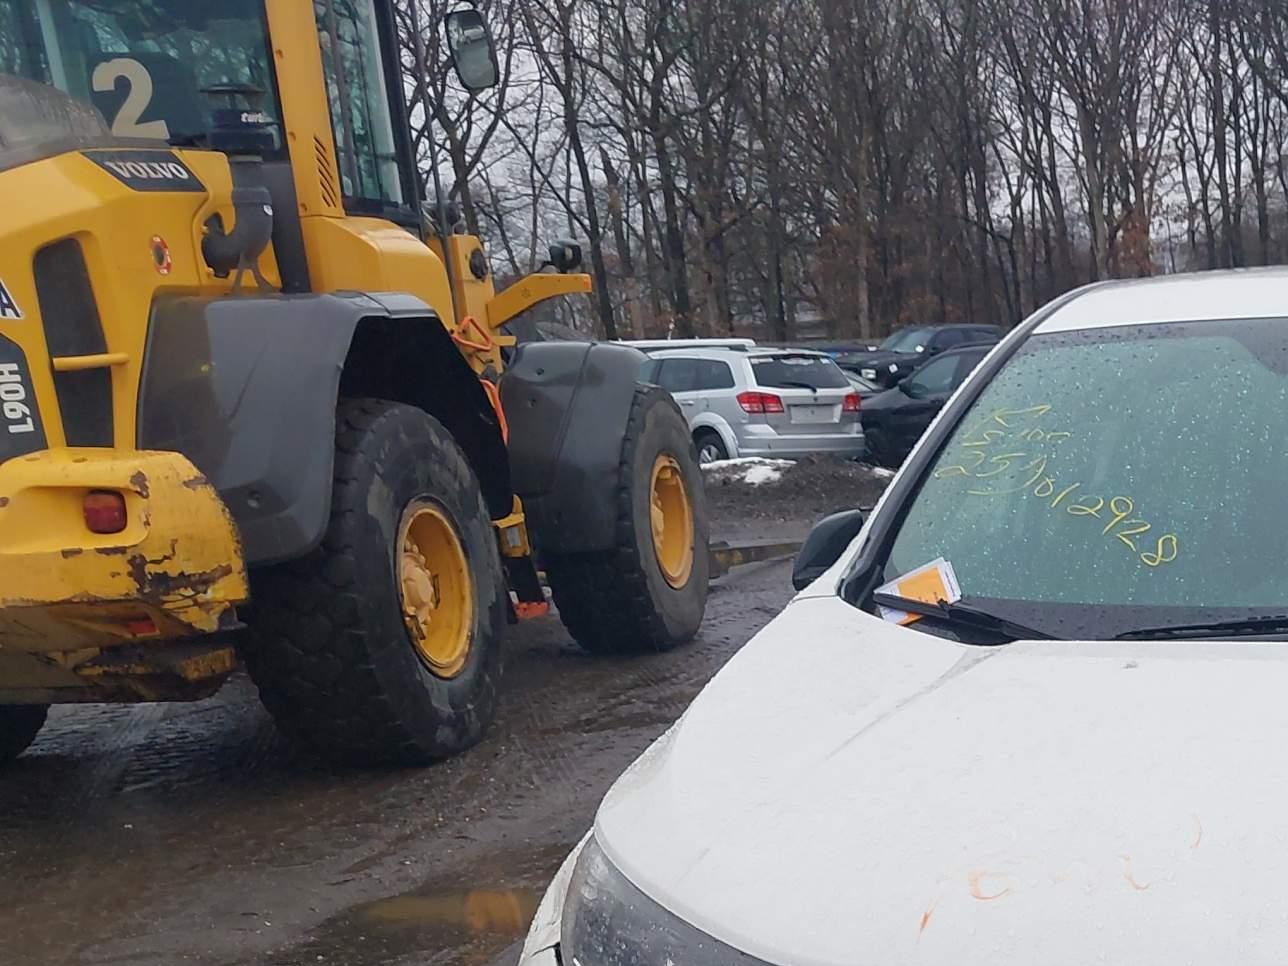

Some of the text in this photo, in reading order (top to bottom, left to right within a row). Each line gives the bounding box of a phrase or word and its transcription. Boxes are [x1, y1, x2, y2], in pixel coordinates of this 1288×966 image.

[92, 57, 171, 140] 2
[104, 160, 189, 181] VOLVO
[0, 363, 35, 433] L90H
